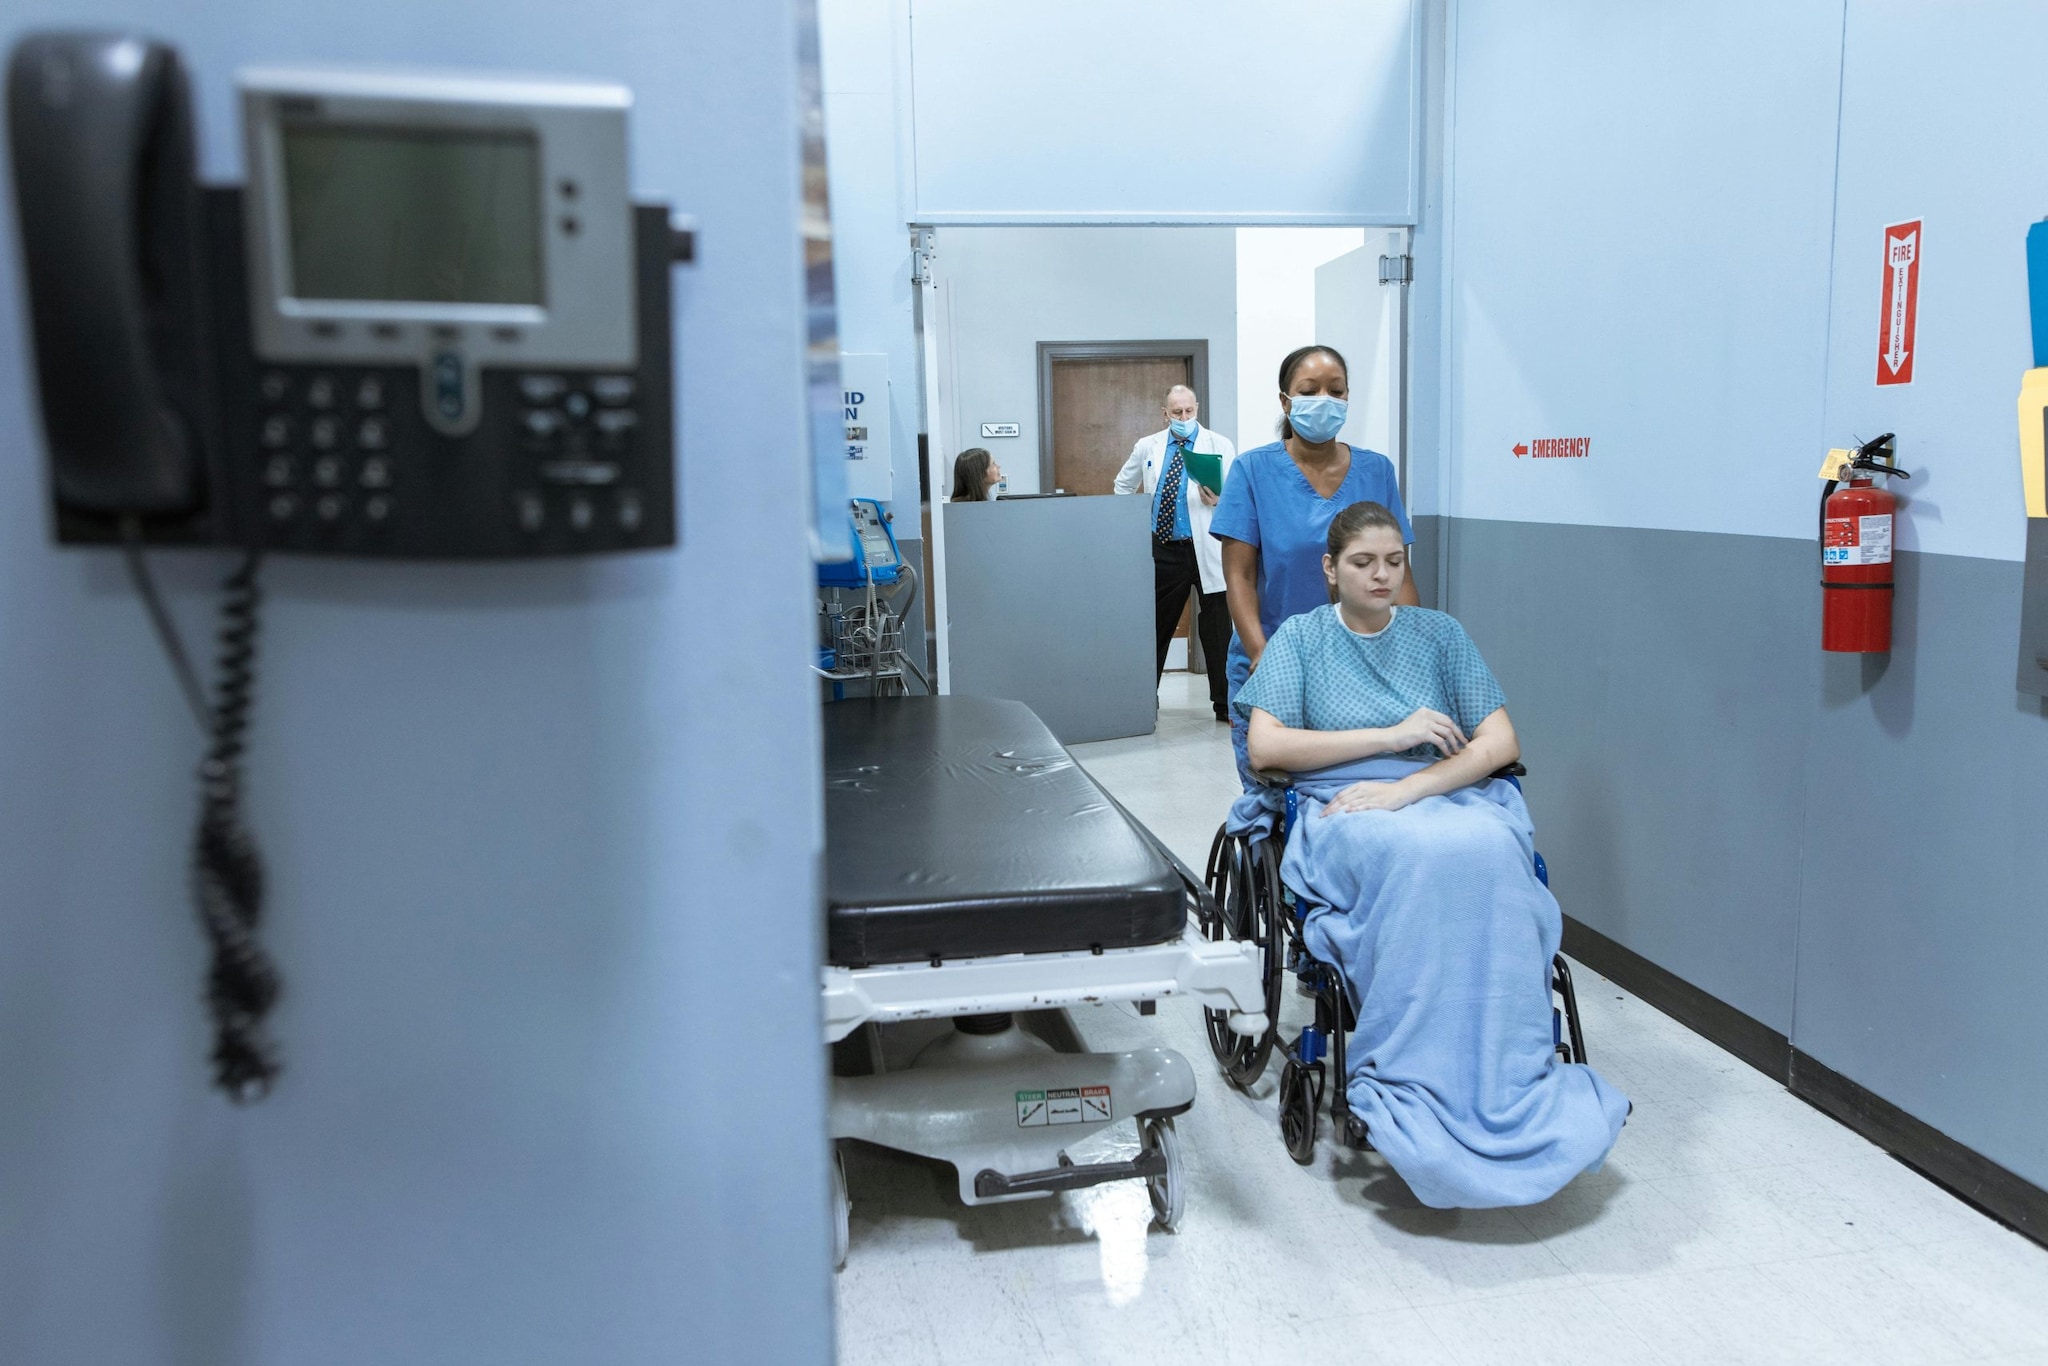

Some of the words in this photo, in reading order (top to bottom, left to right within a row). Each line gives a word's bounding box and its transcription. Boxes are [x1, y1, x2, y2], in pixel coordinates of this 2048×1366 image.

[1893, 244, 1912, 262] FIRE
[1893, 267, 1904, 368] EXTINGUISHER
[1532, 437, 1591, 458] EMERGENCY
[1047, 1089, 1079, 1099] NEUTRAL
[1084, 1087, 1107, 1097] BRAKE
